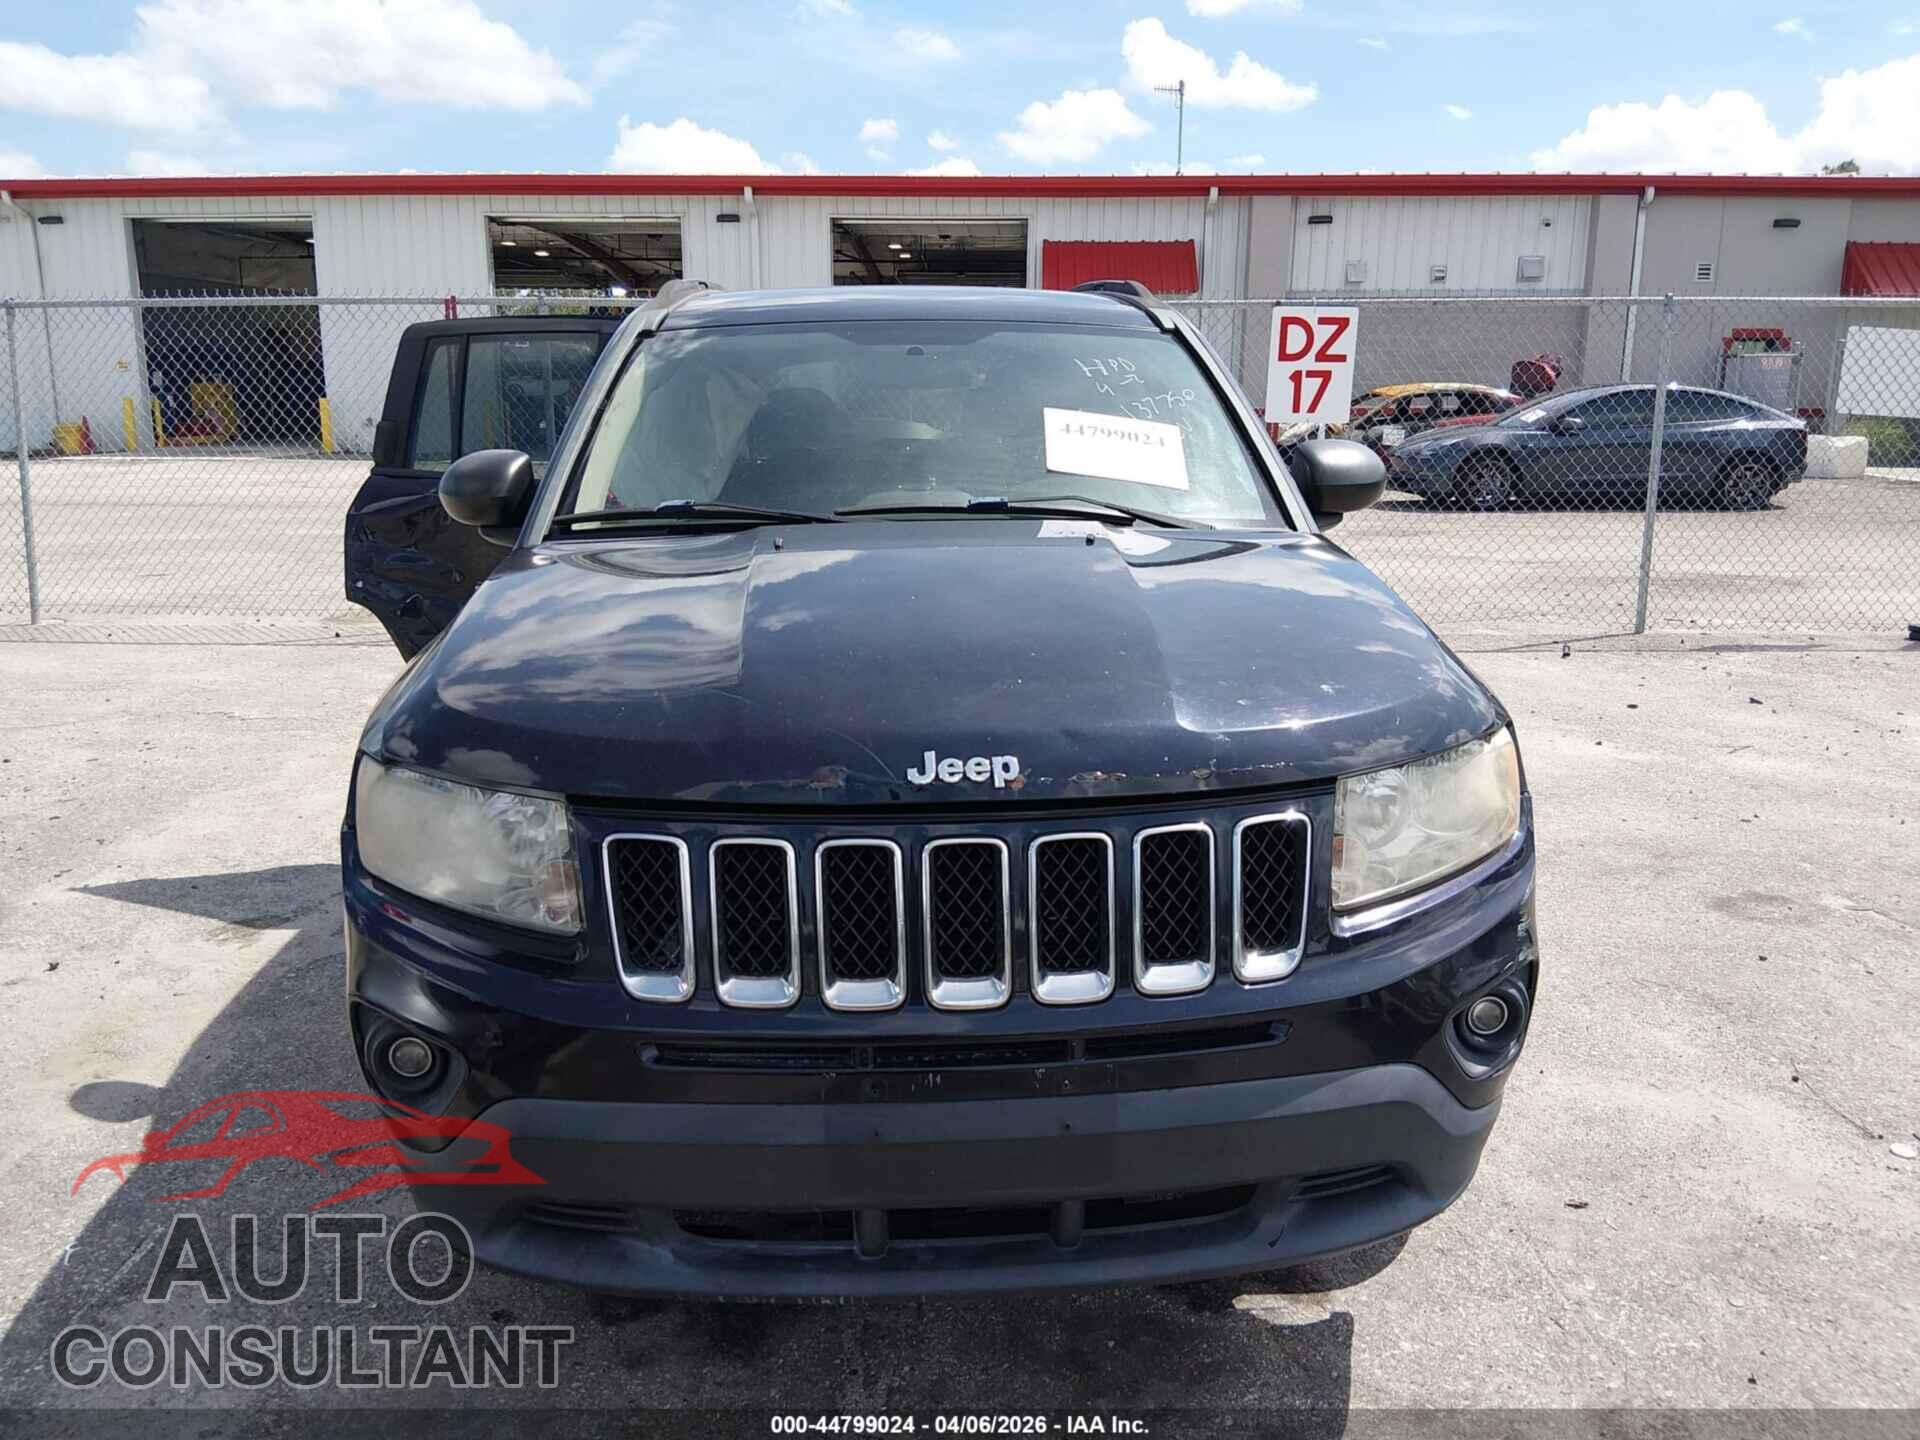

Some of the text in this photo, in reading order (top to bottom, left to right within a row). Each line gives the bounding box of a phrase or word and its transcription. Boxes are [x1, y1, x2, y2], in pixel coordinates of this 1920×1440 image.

[1277, 316, 1351, 363] DZ
[1287, 369, 1333, 414] 17
[906, 750, 1020, 788] Jeep
